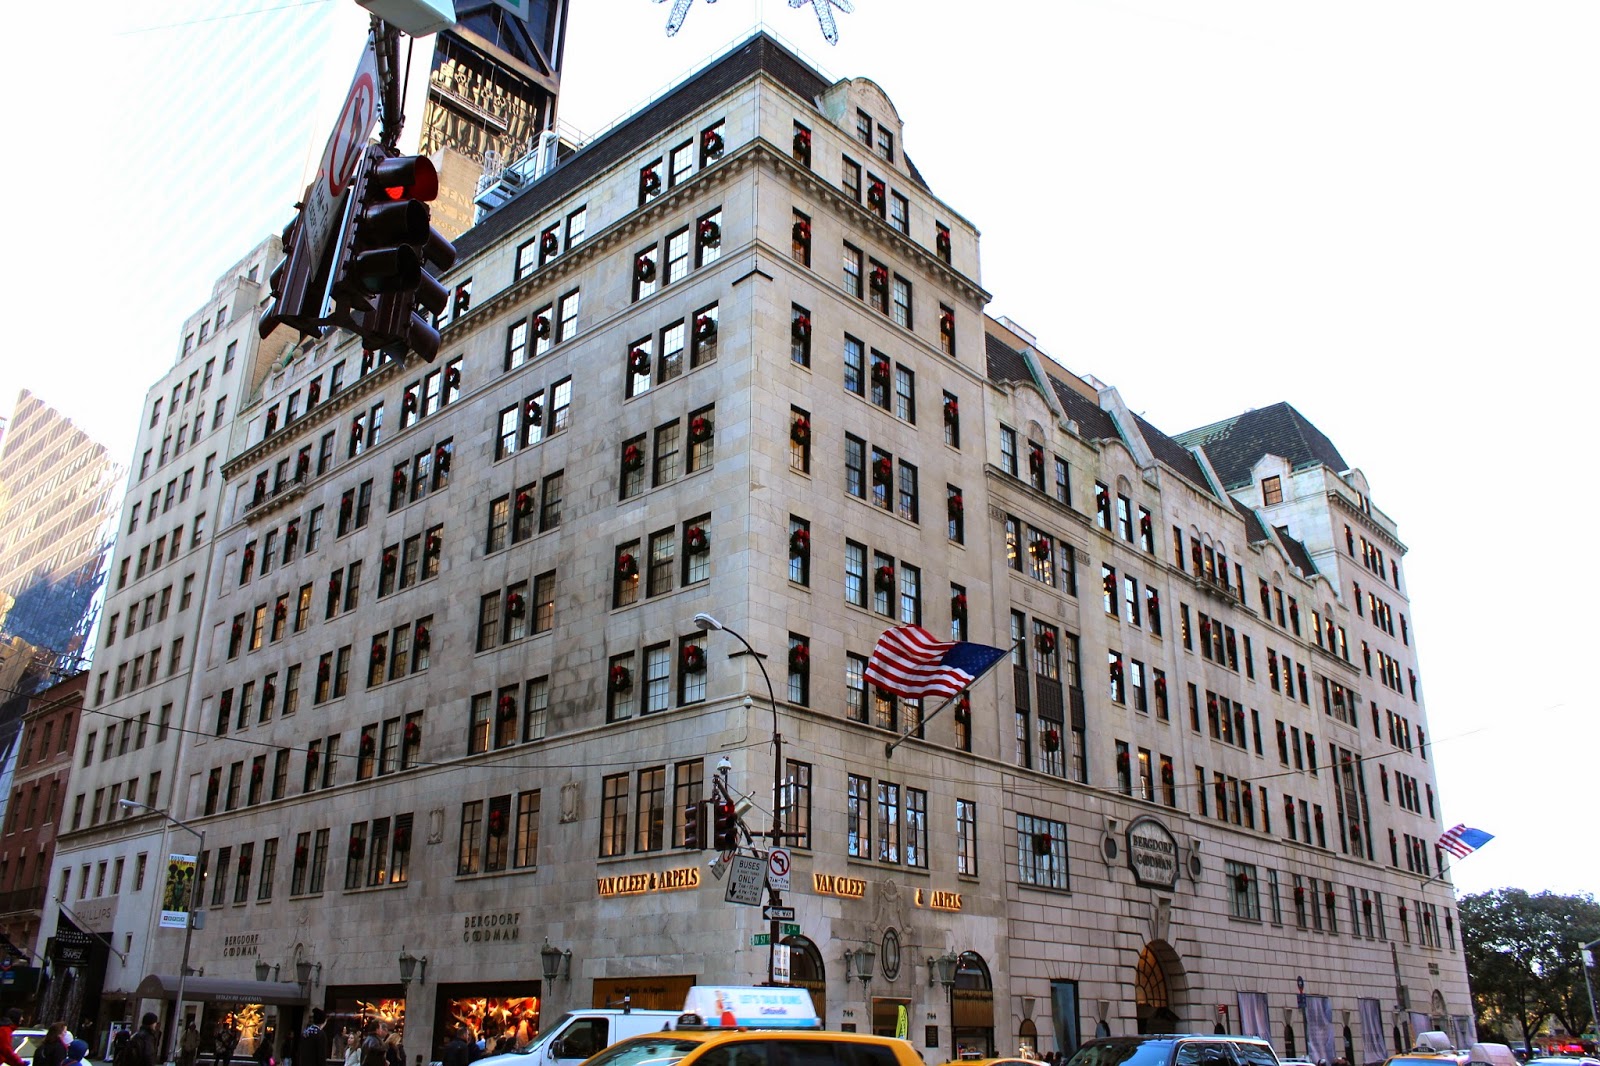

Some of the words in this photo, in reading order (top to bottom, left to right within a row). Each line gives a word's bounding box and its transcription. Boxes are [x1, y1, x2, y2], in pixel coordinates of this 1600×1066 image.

[1132, 835, 1173, 854] BERGDORF
[739, 860, 760, 871] BUSES
[1136, 854, 1173, 870] GOODMAN
[597, 878, 615, 894] VAN
[616, 874, 648, 892] CLEEF
[649, 873, 656, 890] &
[658, 868, 698, 889] ARPELS
[738, 875, 757, 884] ONLY
[815, 874, 835, 892] VAN
[836, 877, 867, 897] CLEEF
[917, 889, 924, 905] &
[931, 891, 963, 909] ARPELS
[76, 908, 112, 922] PHILLIPS
[464, 913, 520, 928] BERGDORF
[463, 928, 519, 943] GOODMAN
[787, 925, 791, 933] 5
[224, 934, 259, 946] BERGDORF
[223, 945, 258, 957] GOODMAN
[842, 1010, 854, 1018] 744
[926, 1012, 937, 1020] 744
